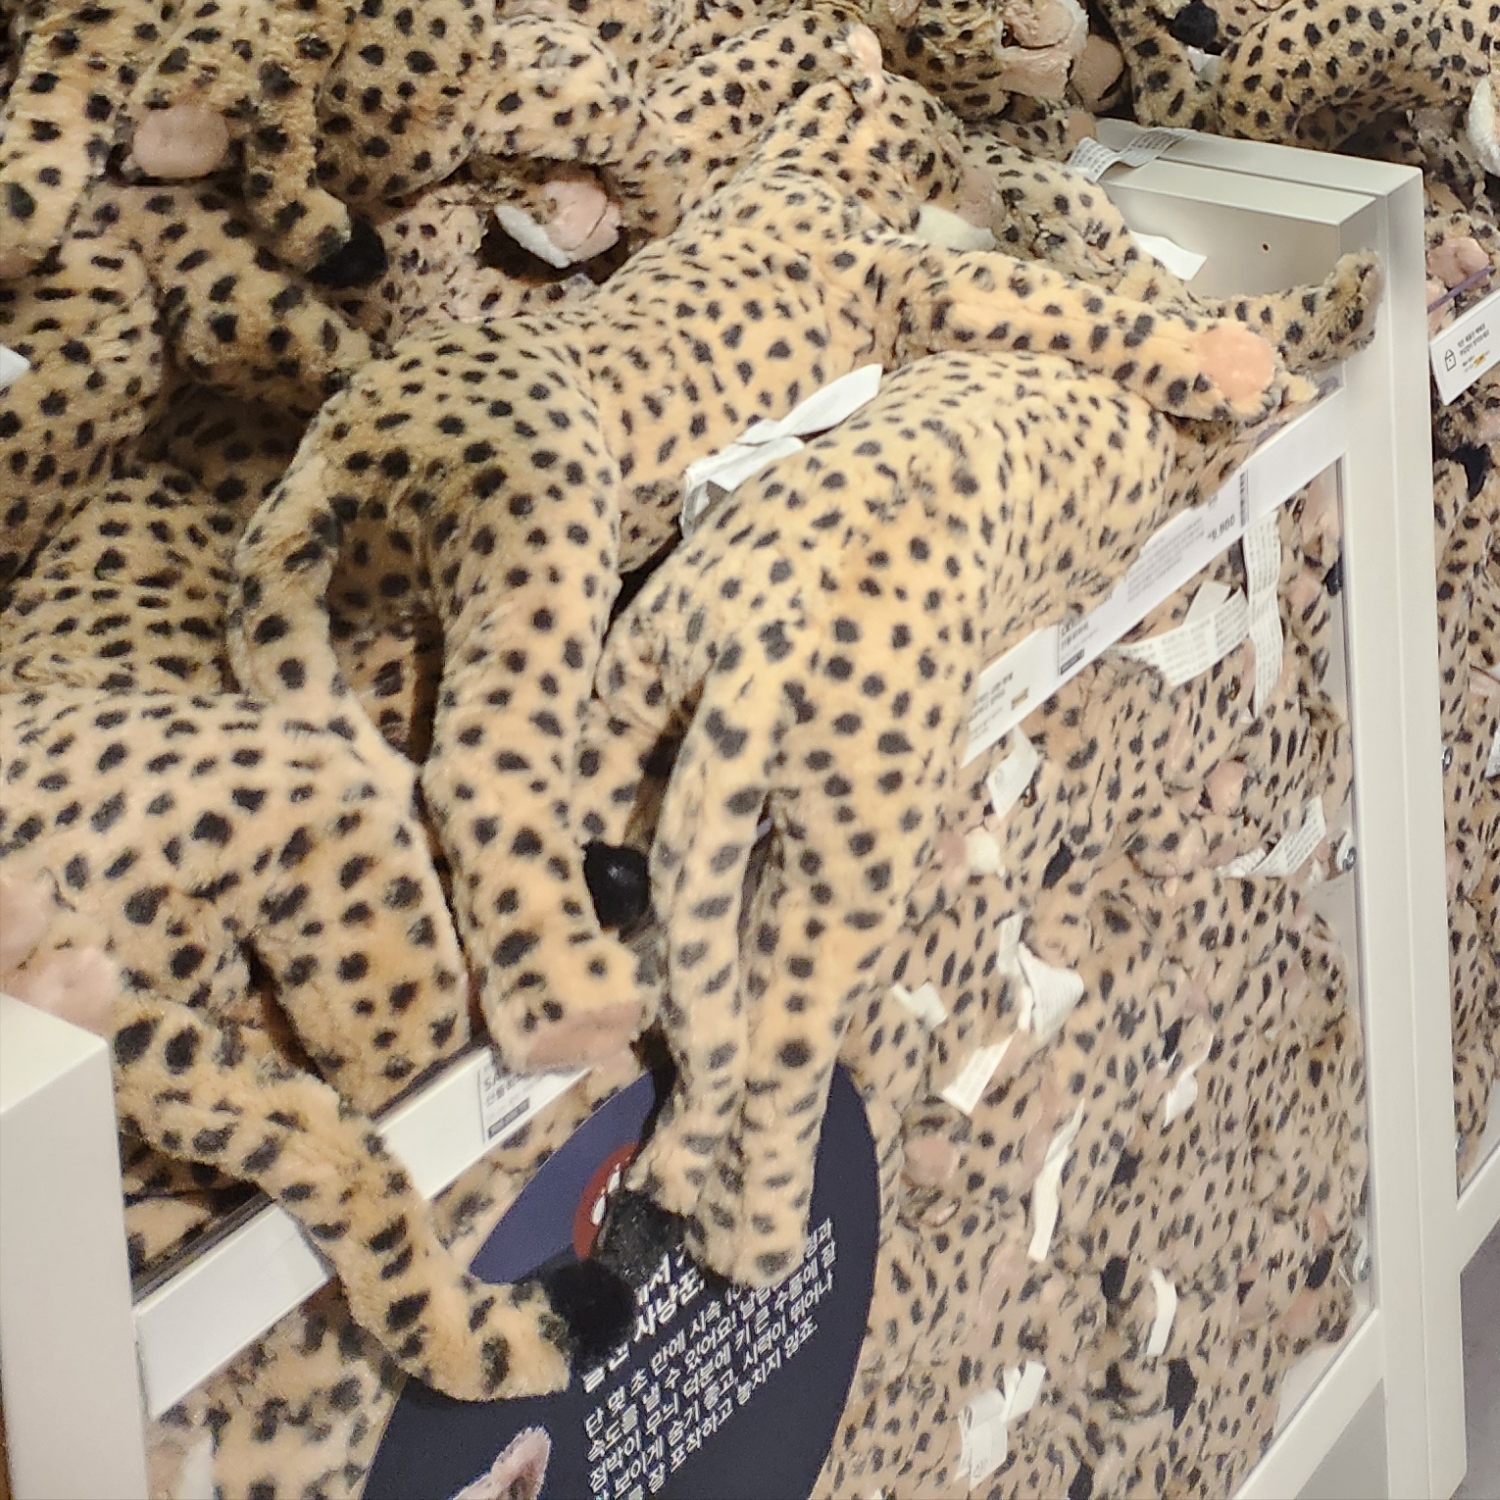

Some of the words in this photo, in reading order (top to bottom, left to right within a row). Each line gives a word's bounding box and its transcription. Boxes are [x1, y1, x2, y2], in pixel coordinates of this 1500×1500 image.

[585, 1406, 605, 1439] 단
[631, 1367, 649, 1398] 초
[651, 1328, 687, 1377] 만에
[690, 1299, 722, 1340] 시속
[587, 1403, 639, 1463] 속도를
[665, 1367, 682, 1389] 수
[685, 1310, 738, 1375] 있어요!
[590, 1429, 642, 1493] 점박이
[646, 1392, 680, 1436] 무늬
[683, 1342, 732, 1398] 덕분에
[735, 1325, 750, 1351] 키
[614, 1434, 664, 1499] 보이게
[667, 1399, 700, 1447] 숨기
[743, 1314, 786, 1371] 시력이
[791, 1269, 833, 1323] 뛰어나
[670, 1397, 734, 1473] 포착하고
[737, 1348, 781, 1406] 놓치지
